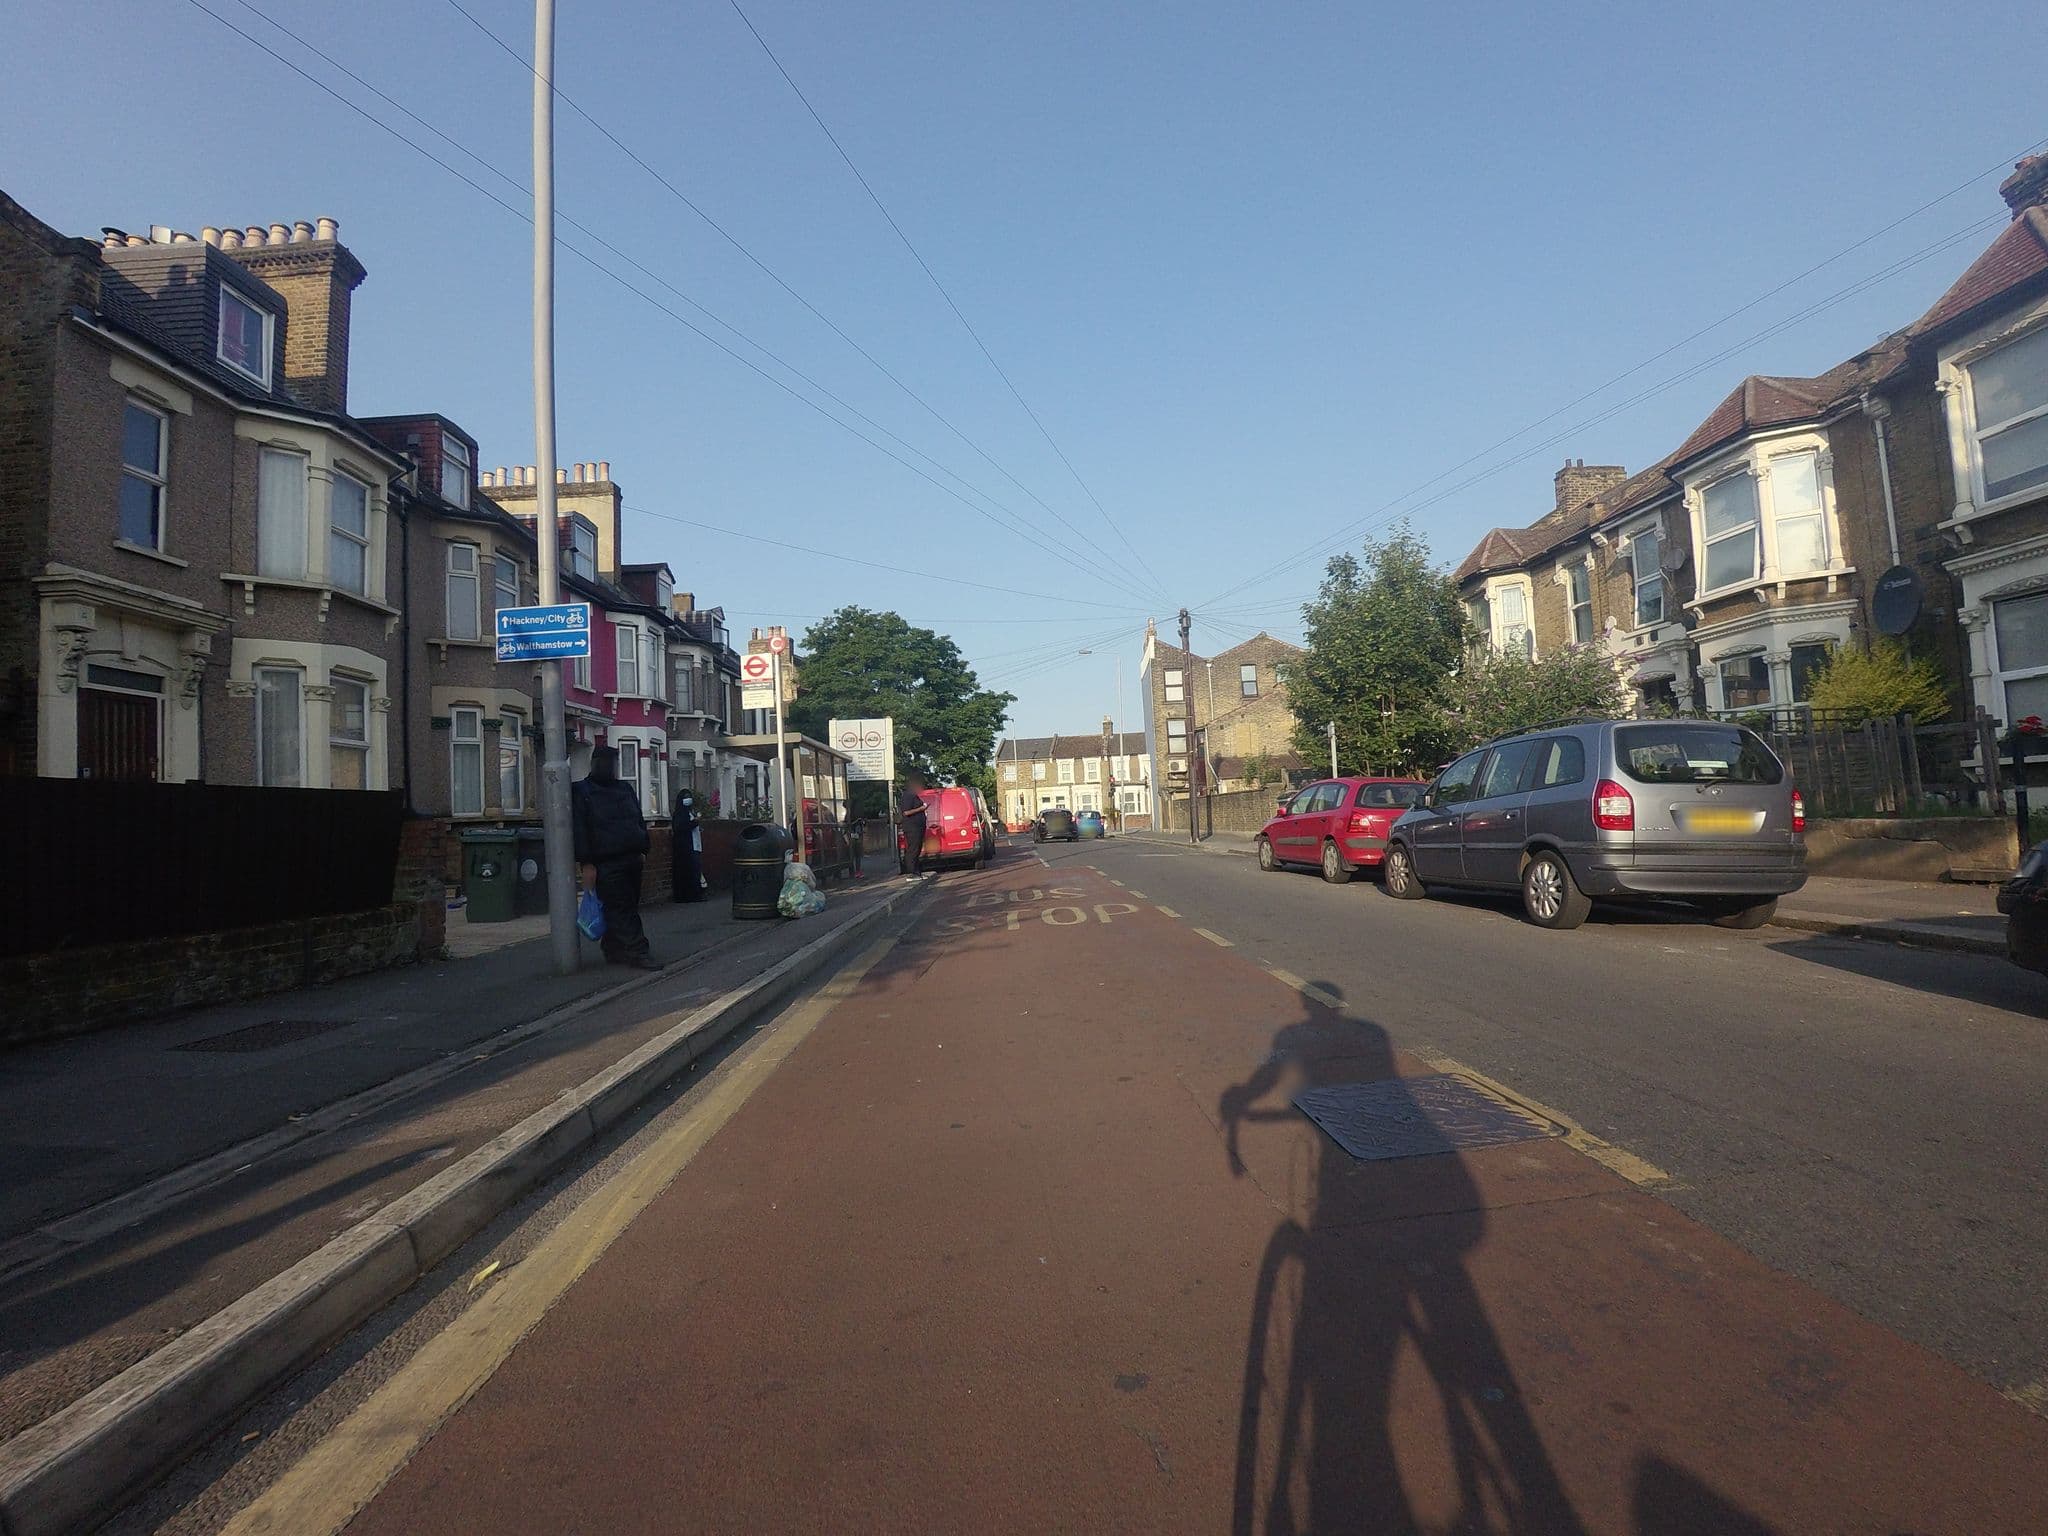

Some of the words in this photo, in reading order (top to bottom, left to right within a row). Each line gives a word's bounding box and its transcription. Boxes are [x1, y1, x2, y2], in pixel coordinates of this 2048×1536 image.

[509, 614, 566, 625] Hackney/City
[516, 641, 573, 651] Walthamstow
[967, 887, 1088, 908] BUS
[933, 903, 1139, 937] STOP
